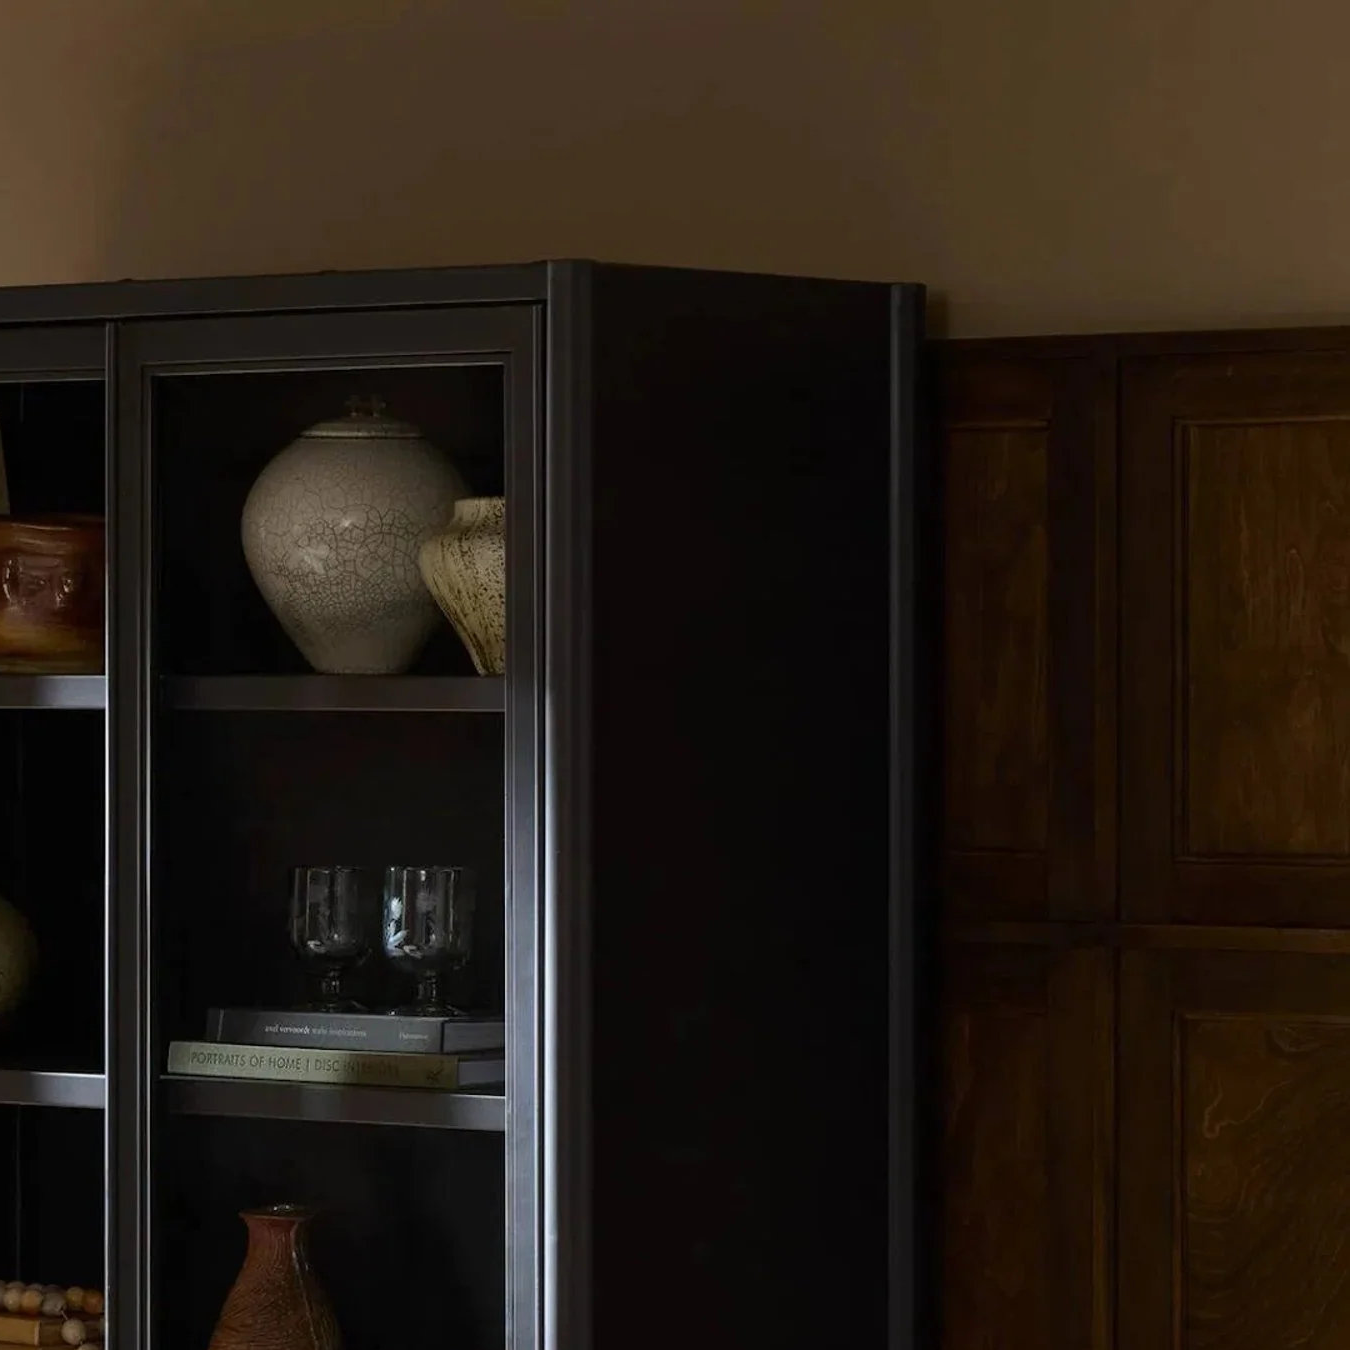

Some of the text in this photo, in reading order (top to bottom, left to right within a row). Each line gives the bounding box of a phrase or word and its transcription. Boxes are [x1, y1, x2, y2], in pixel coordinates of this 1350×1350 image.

[190, 1051, 246, 1068] PORTRAITS
[249, 1055, 266, 1068] OF
[268, 1056, 301, 1071] HOME
[314, 1058, 341, 1073] DISC
